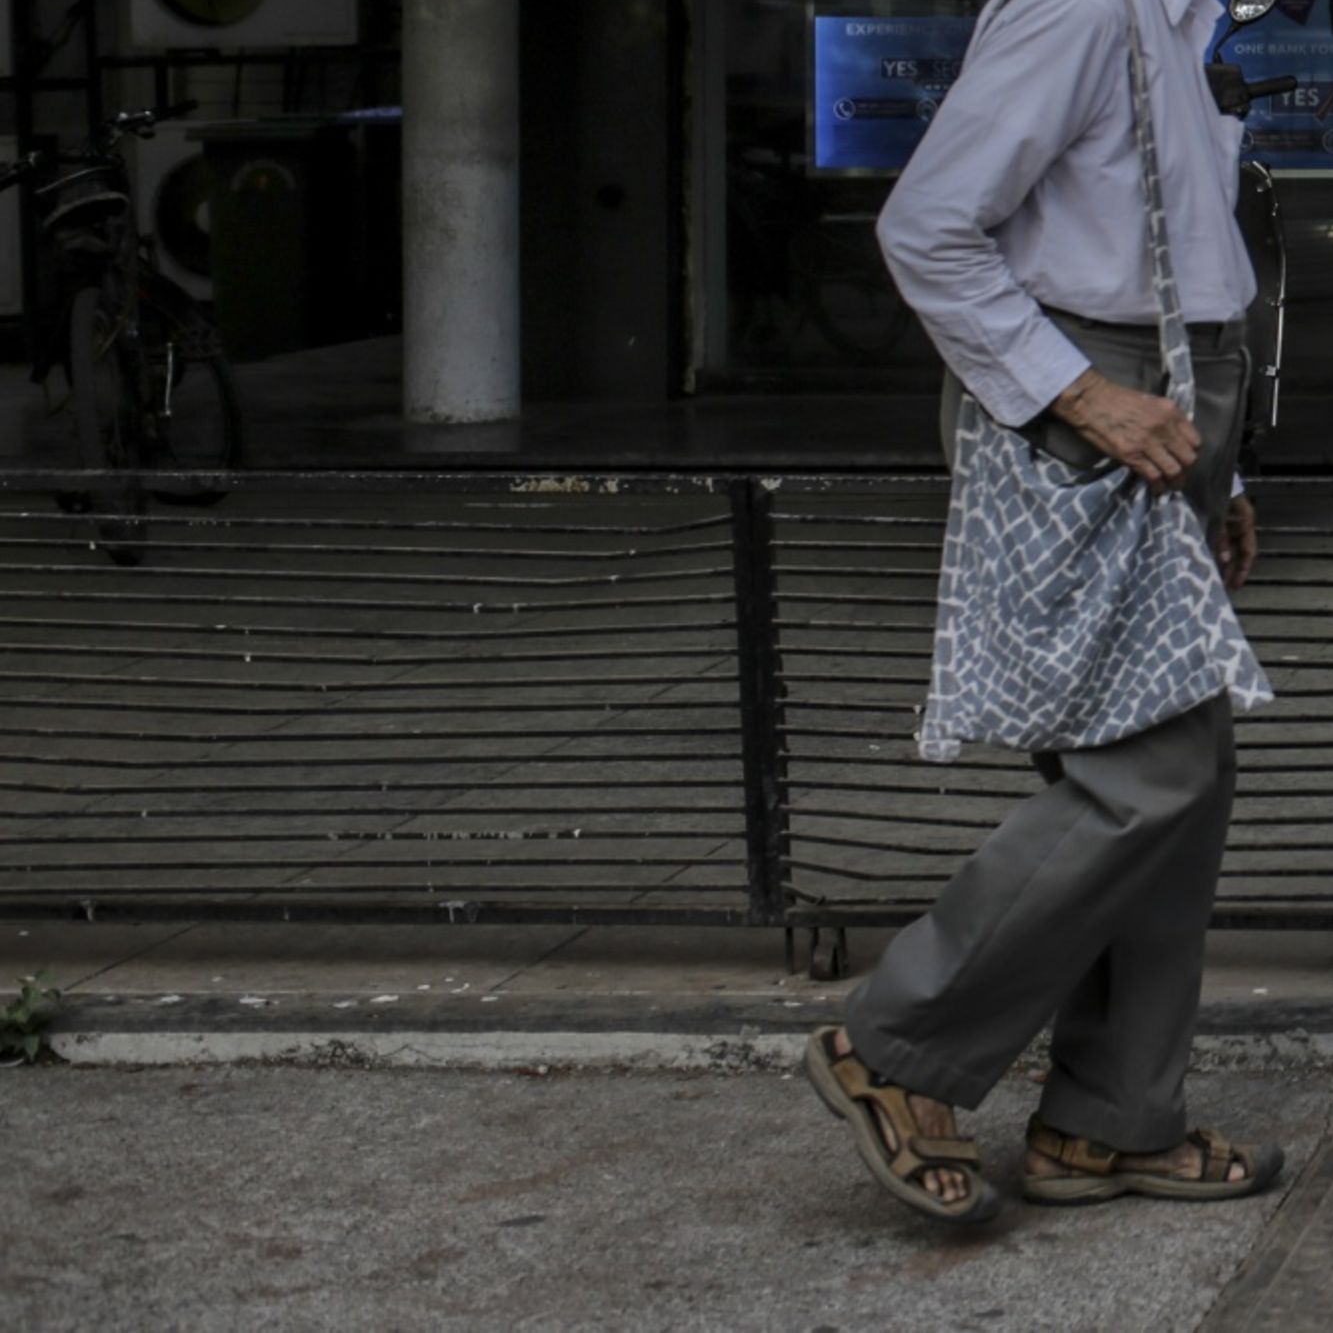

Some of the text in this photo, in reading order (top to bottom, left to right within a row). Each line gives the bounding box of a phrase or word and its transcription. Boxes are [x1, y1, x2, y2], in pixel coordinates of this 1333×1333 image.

[1234, 43, 1264, 55] ONE
[883, 60, 918, 77] YES
[1280, 87, 1320, 107] YES
